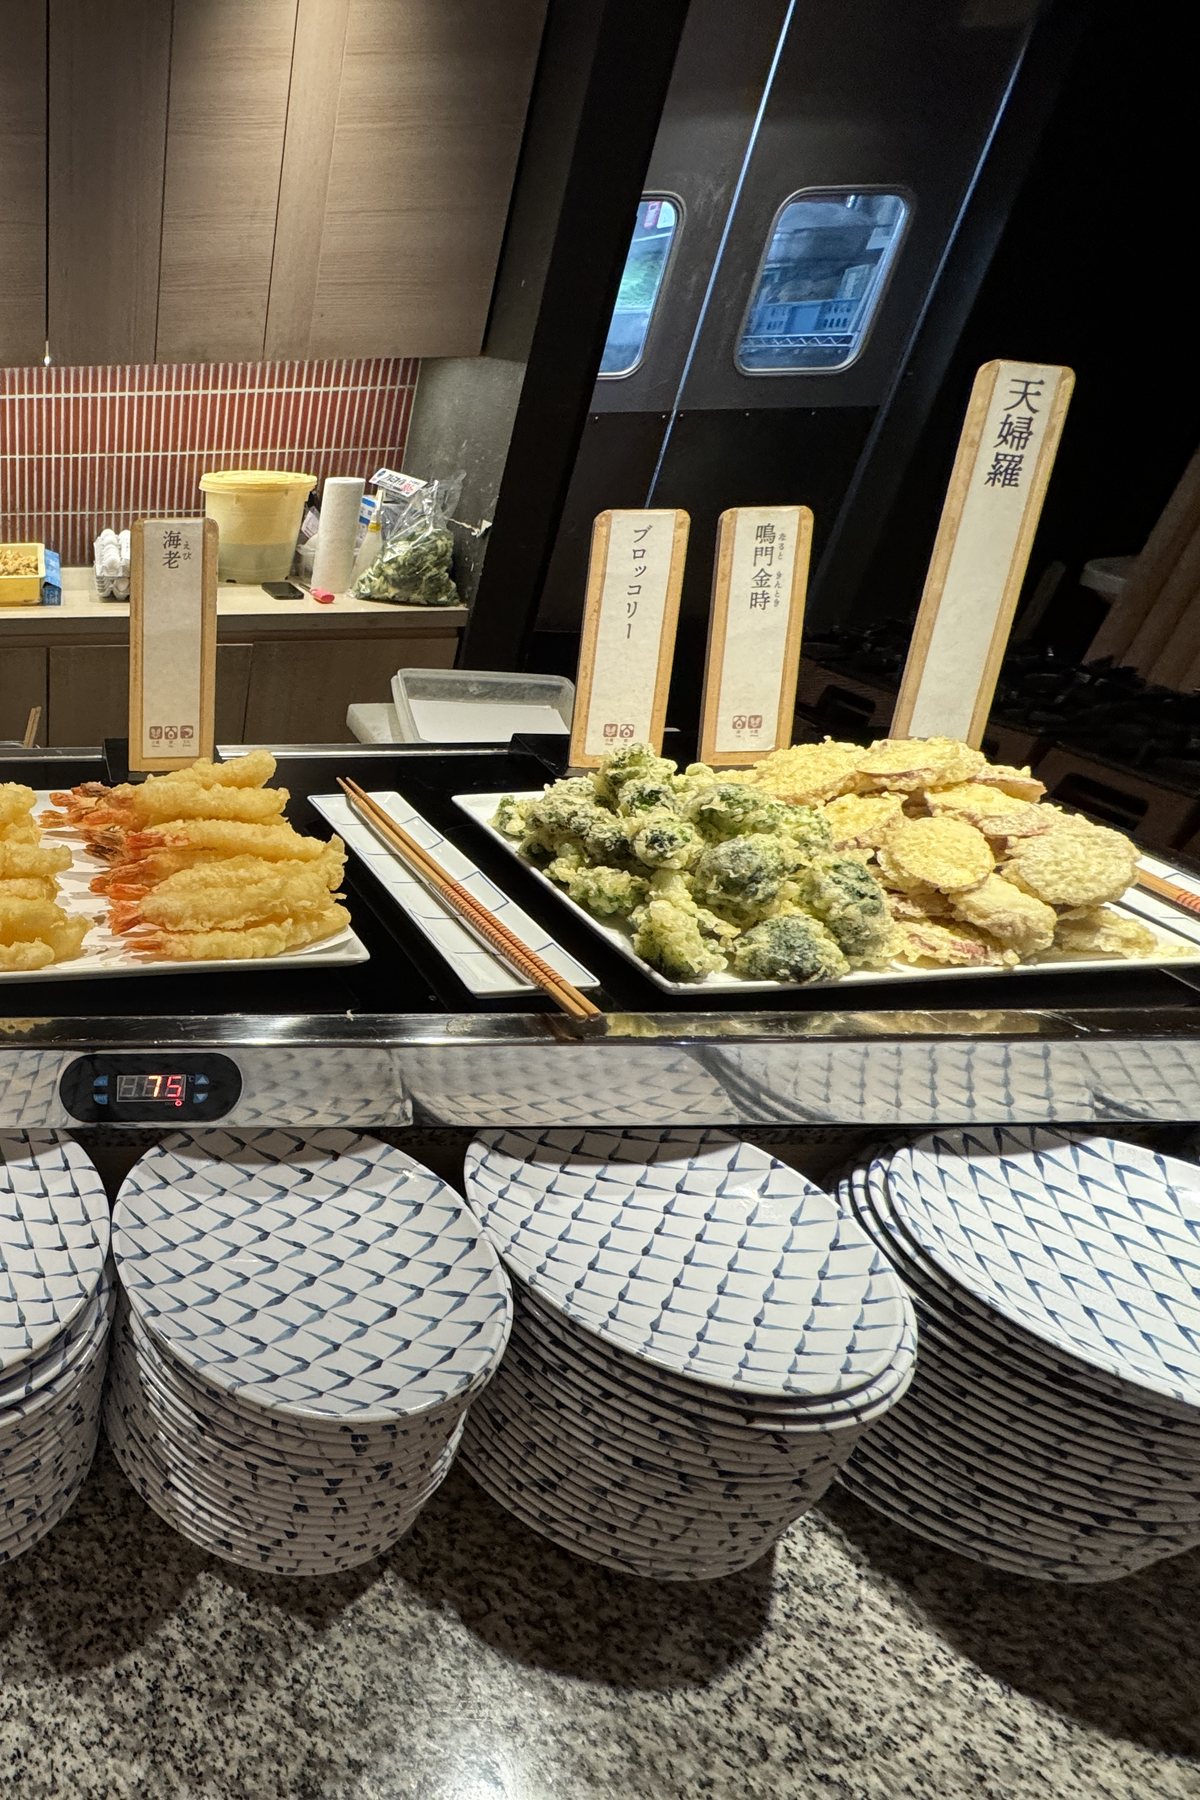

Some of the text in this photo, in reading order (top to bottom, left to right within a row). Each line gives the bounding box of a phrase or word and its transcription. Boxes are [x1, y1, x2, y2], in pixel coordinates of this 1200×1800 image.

[984, 378, 1045, 488] 天婦羅
[162, 530, 182, 569] 海老
[183, 541, 191, 561] えび
[749, 523, 776, 611] 鳴門金時
[626, 524, 653, 639] ブロッコリー
[148, 1075, 182, 1097] 75
